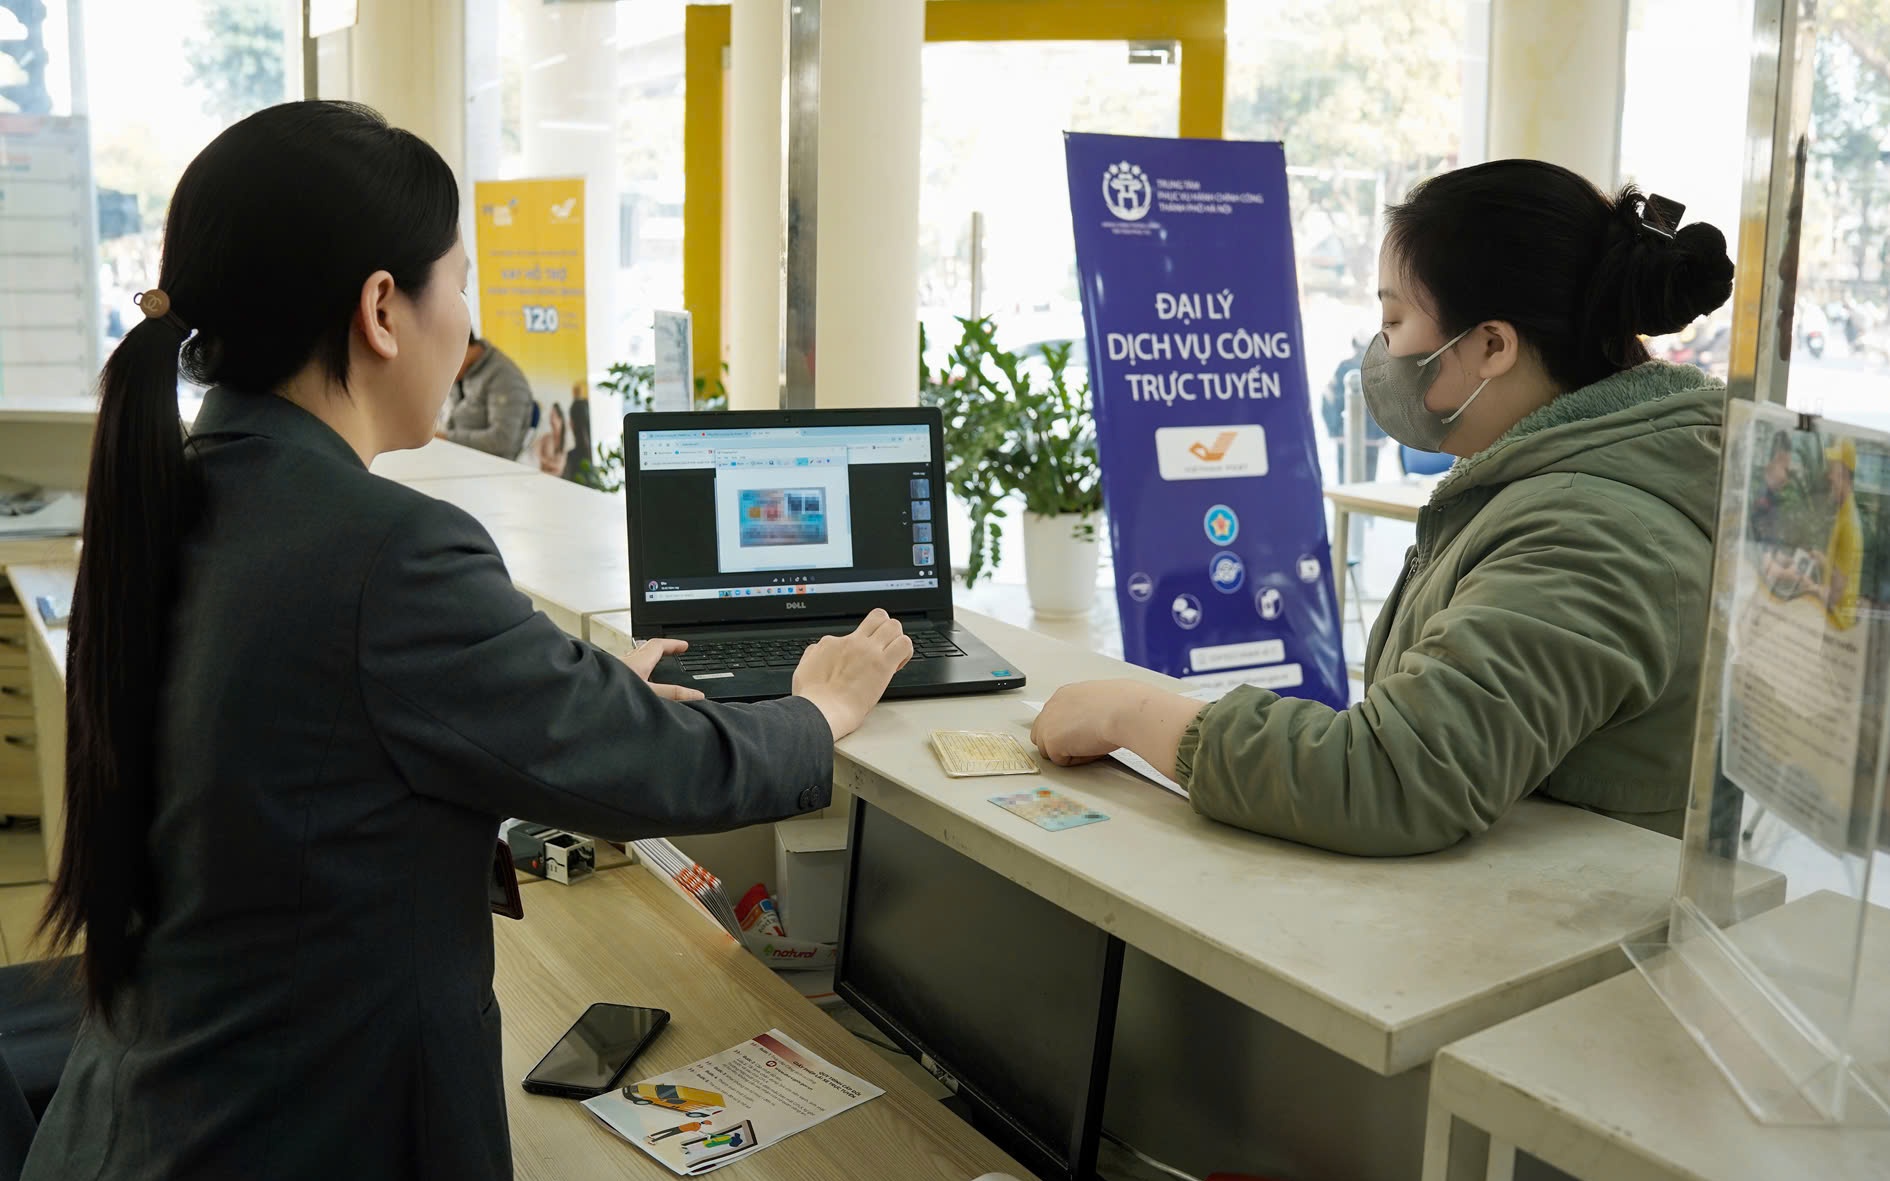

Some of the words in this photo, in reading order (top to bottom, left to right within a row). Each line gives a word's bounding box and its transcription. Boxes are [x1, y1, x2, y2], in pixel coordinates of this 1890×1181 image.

[522, 304, 560, 332] 120
[1155, 292, 1201, 325] ĐẠI
[1207, 288, 1234, 320] LÝ
[1107, 332, 1172, 366] DỊCH
[1173, 333, 1212, 365] VỤ
[1216, 327, 1291, 359] CÔNG
[1125, 370, 1197, 407] TRỰC
[1197, 364, 1281, 400] TUYẾN
[786, 602, 807, 610] DELL
